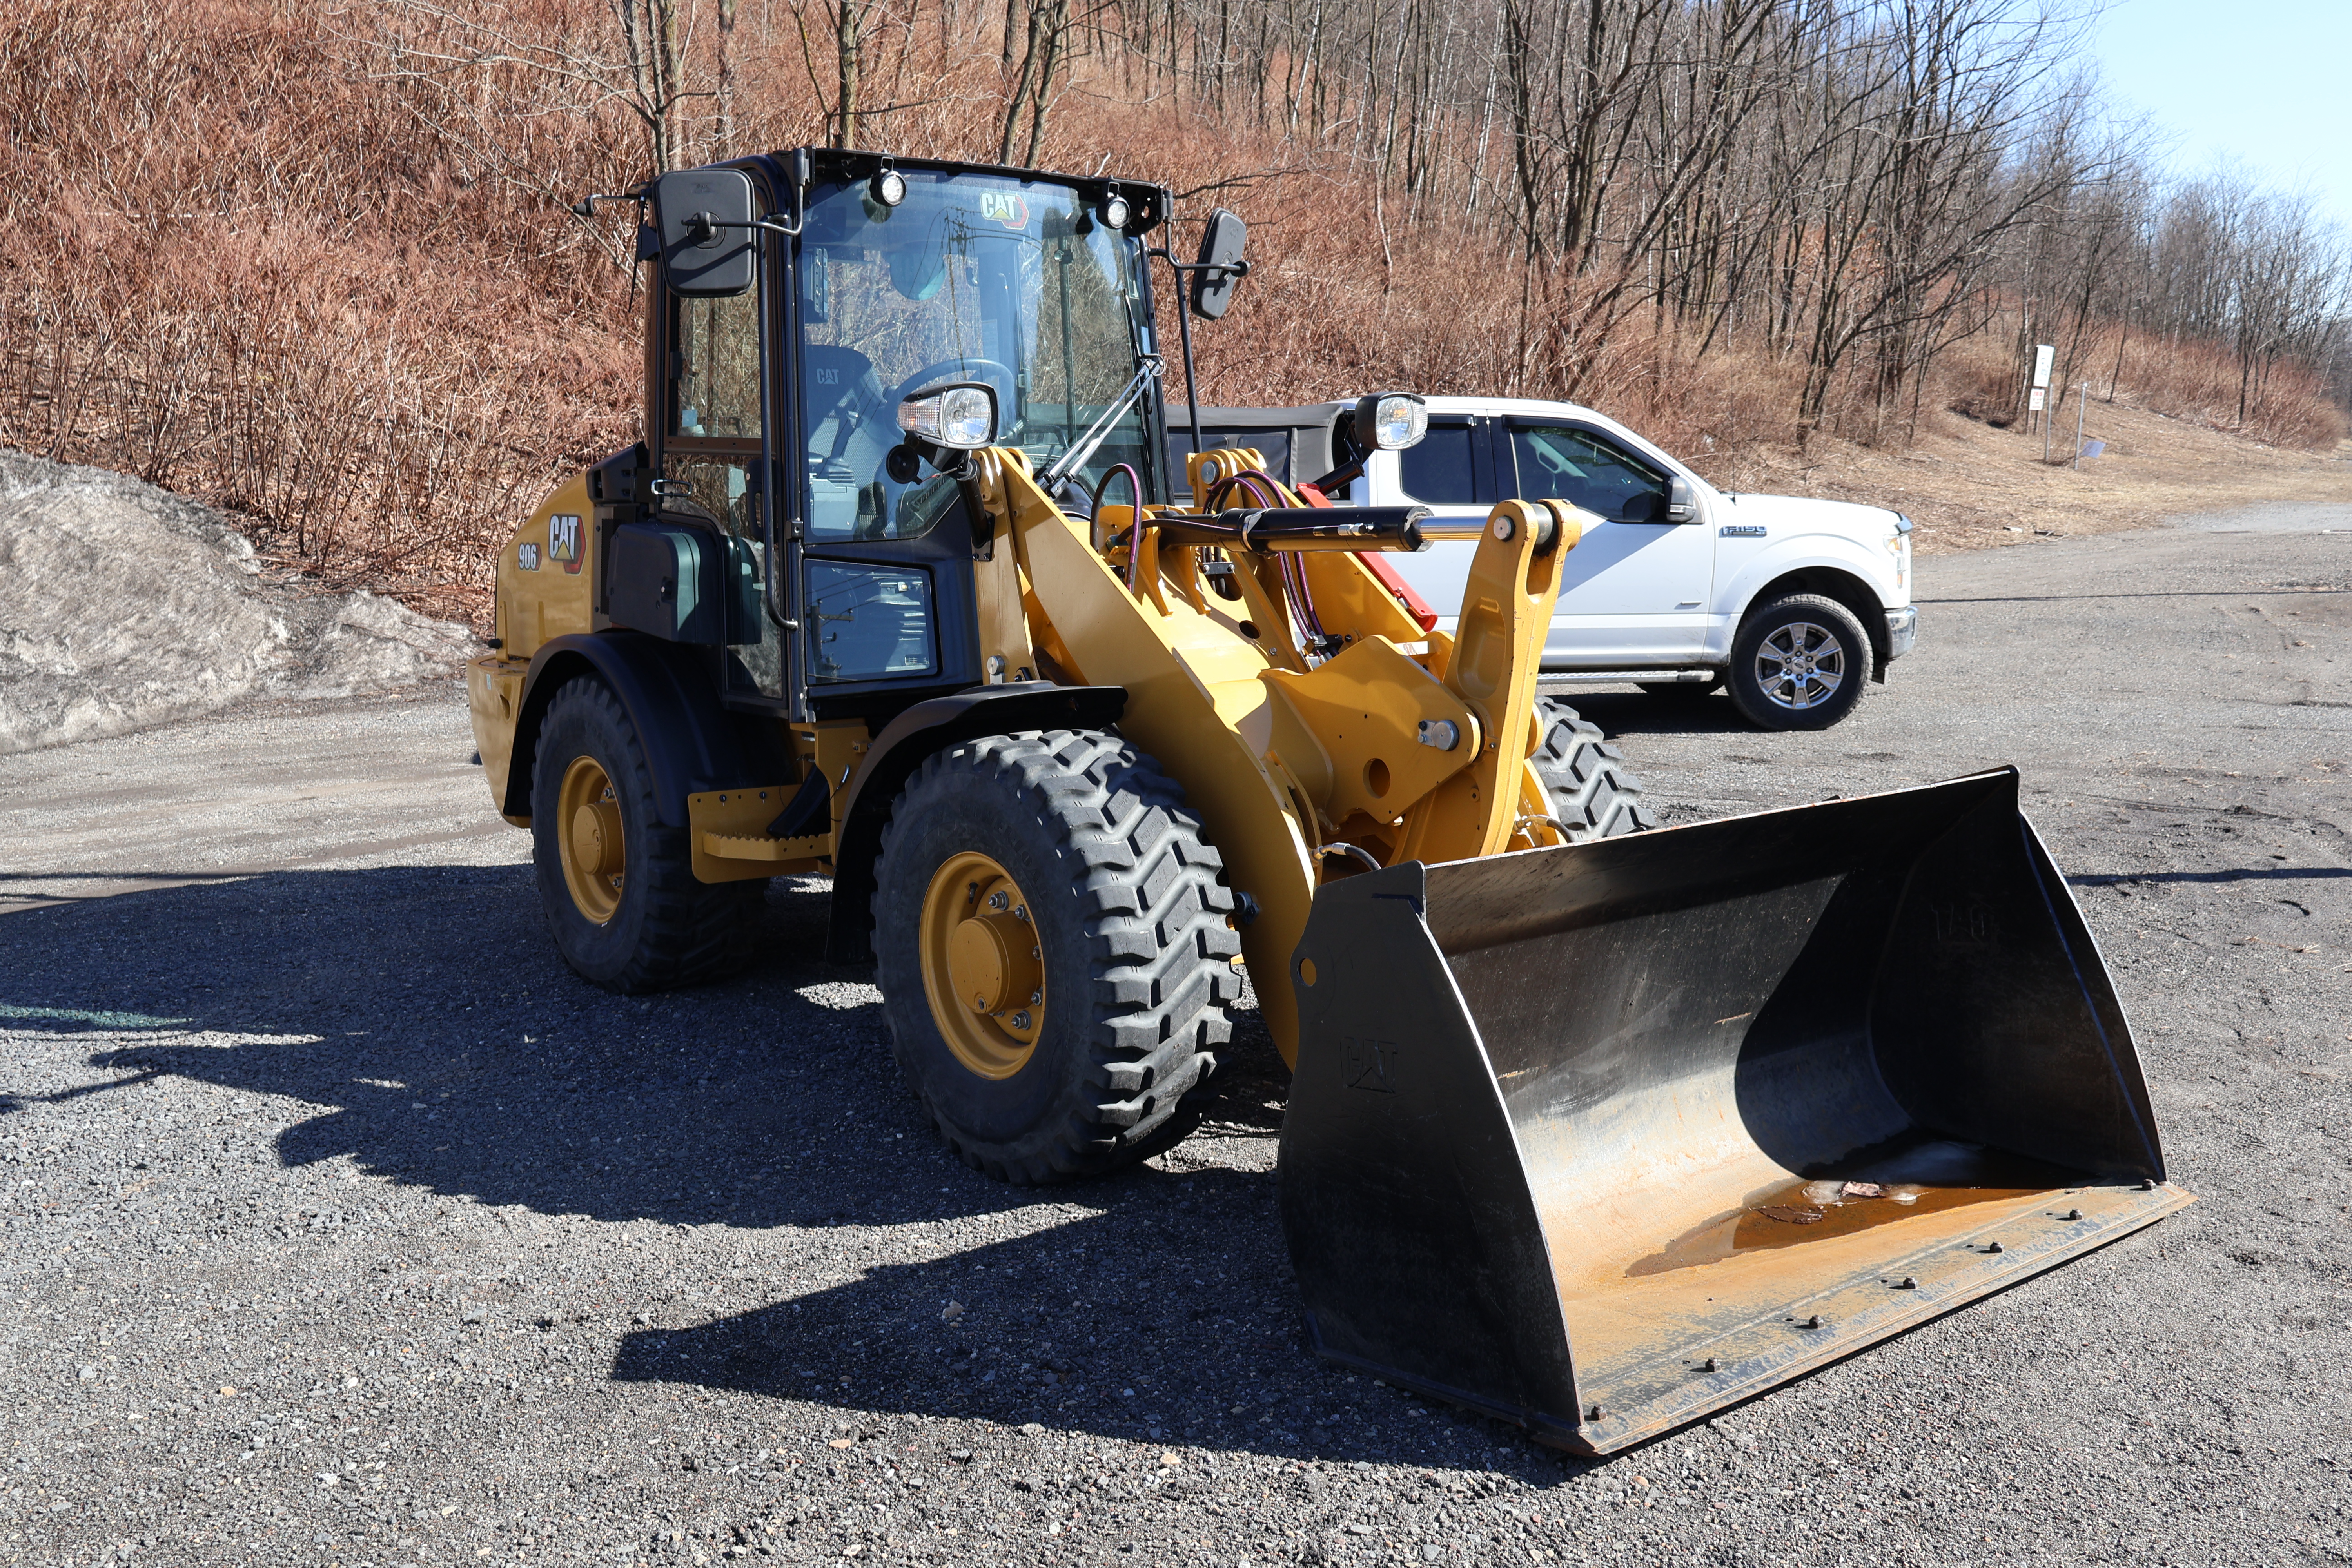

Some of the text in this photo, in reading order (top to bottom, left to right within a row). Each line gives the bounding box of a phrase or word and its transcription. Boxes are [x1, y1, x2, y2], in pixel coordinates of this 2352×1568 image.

[981, 193, 1016, 220] CAT
[817, 368, 839, 385] CAT
[549, 515, 578, 560] CAT
[519, 544, 537, 570] 906
[1340, 1036, 1398, 1094] CAT
